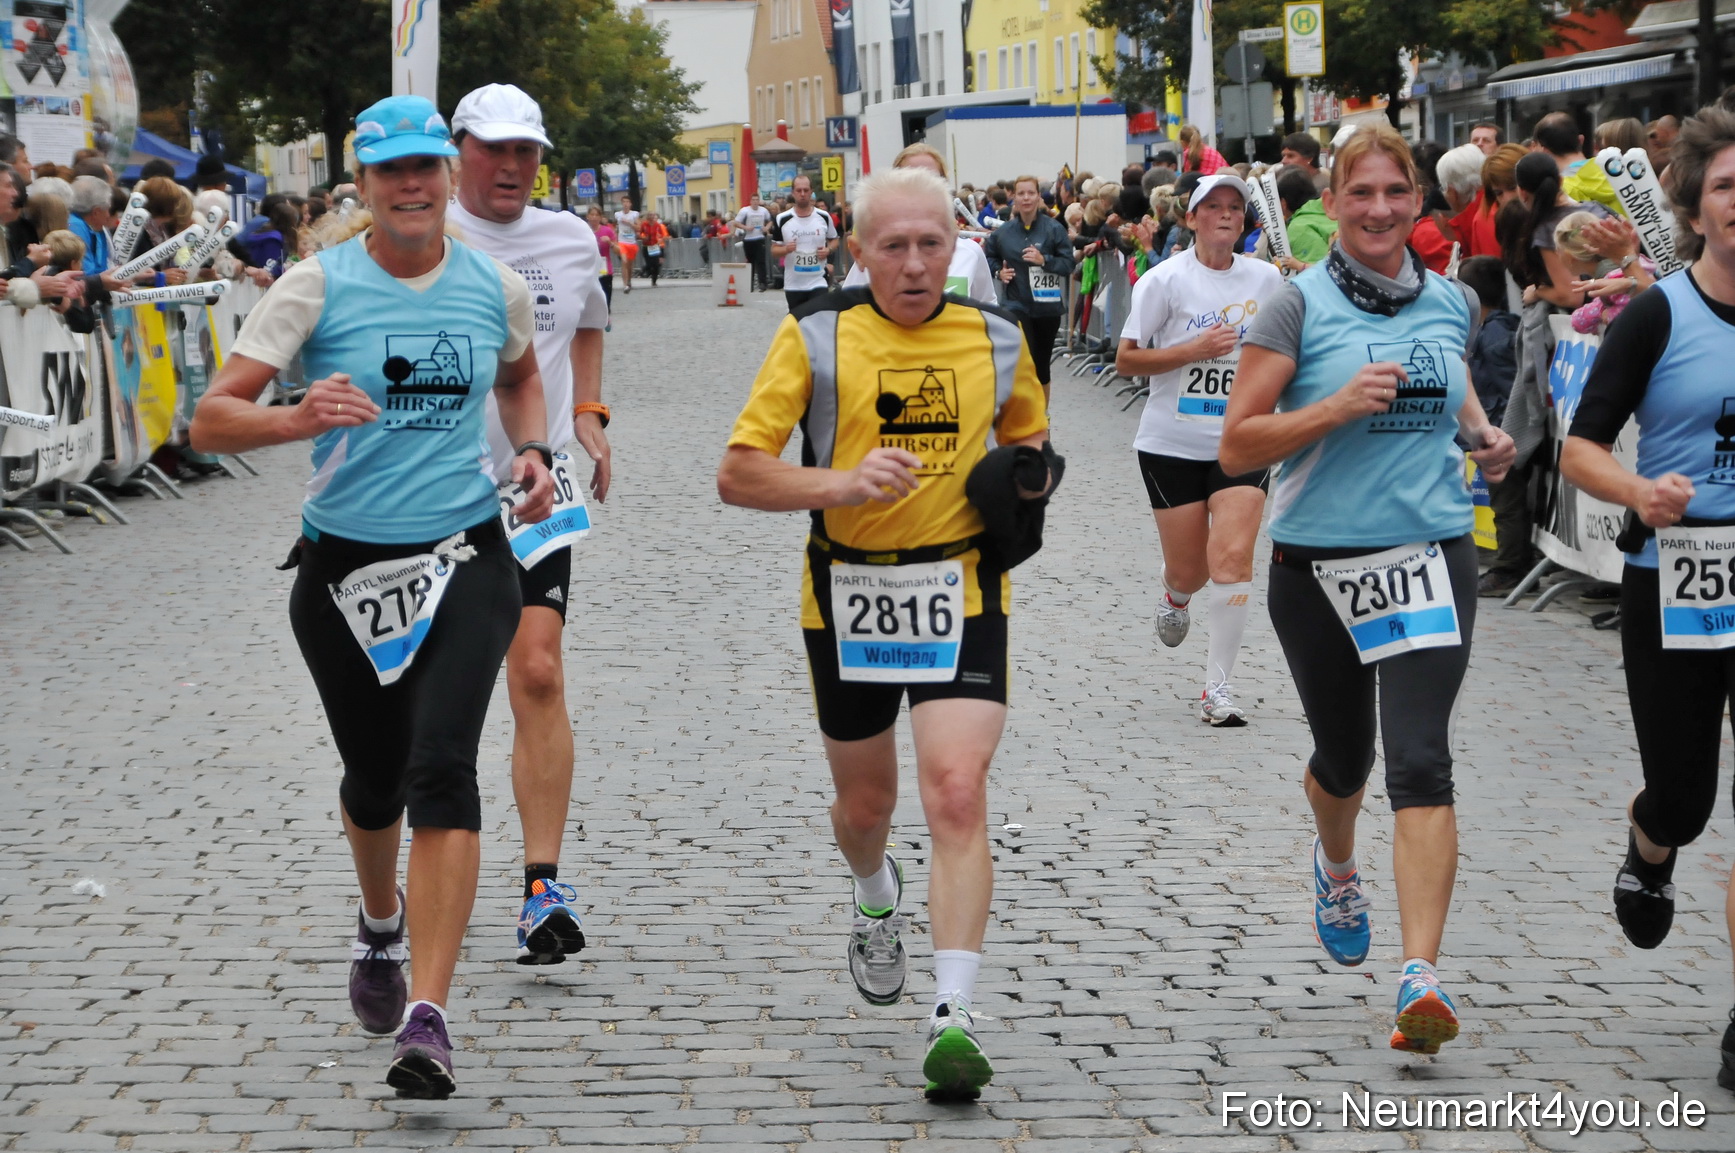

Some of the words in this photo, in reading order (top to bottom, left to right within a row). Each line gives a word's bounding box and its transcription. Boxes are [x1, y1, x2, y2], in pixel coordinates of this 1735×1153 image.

[828, 167, 838, 183] D
[579, 187, 595, 195] TAXI
[668, 186, 685, 195] TAXI
[1264, 180, 1280, 229] Laufsport
[1620, 184, 1652, 226] BMW
[155, 241, 182, 262] BMW
[198, 237, 220, 259] BMW
[796, 255, 819, 266] 2193
[1033, 275, 1060, 288] 2484
[118, 290, 172, 305] Laufsport
[174, 286, 205, 299] BMW
[535, 321, 556, 332] lauf
[1187, 367, 1235, 396] 266
[386, 396, 466, 411] HIRSCH
[1372, 400, 1446, 416] IRSCH
[880, 437, 958, 452] HIRSCH
[499, 466, 573, 532] 26
[535, 516, 575, 539] Werner
[1660, 538, 1701, 551] PARTL
[335, 578, 379, 602] PARTL
[377, 559, 431, 584] Neumarkt
[834, 575, 876, 588] PARTL
[878, 576, 939, 589] Neumarkt
[1337, 563, 1436, 619] 2301
[847, 592, 953, 637] 2816
[1388, 619, 1406, 637] Pia
[864, 646, 938, 668] Wolfgang
